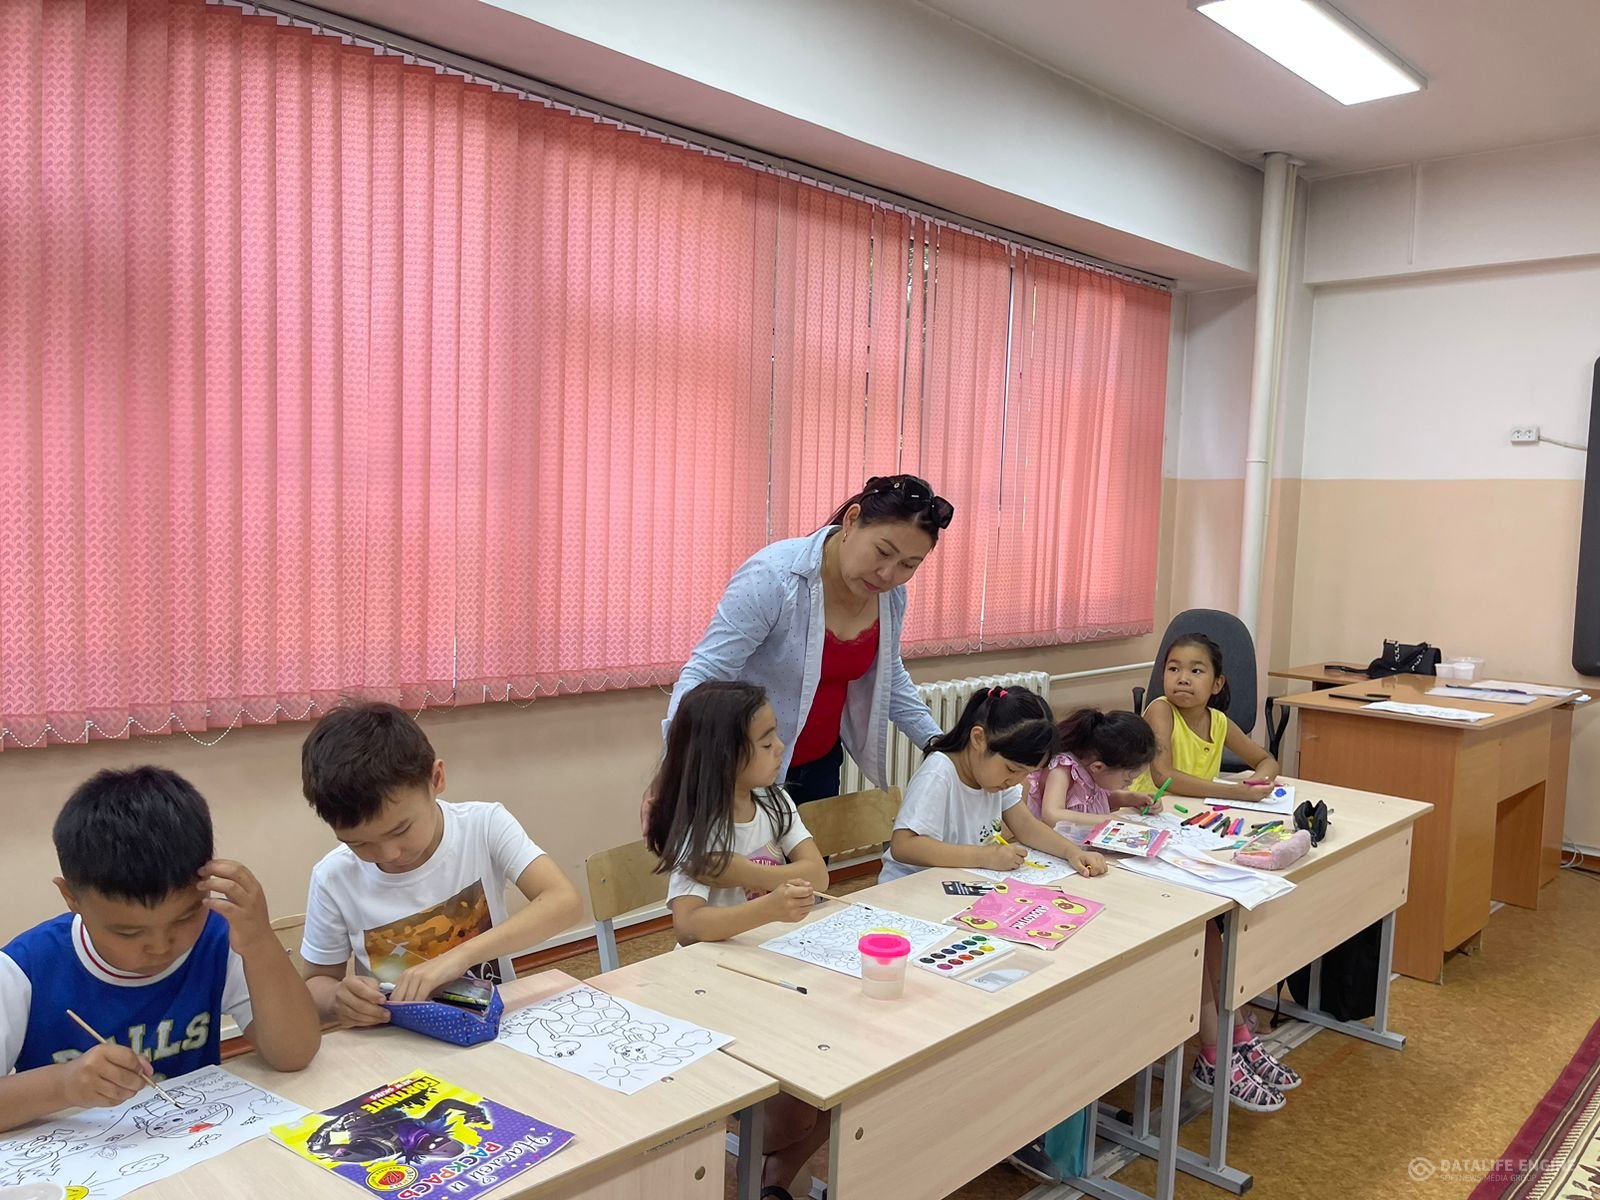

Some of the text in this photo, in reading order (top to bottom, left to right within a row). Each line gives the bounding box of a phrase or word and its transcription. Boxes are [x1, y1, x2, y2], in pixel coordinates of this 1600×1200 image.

[52, 1011, 211, 1064] LLS
[360, 1076, 440, 1115] FORTNITE
[399, 1143, 501, 1199] РАСКРАСЬ
[471, 1134, 549, 1185] Наклей
